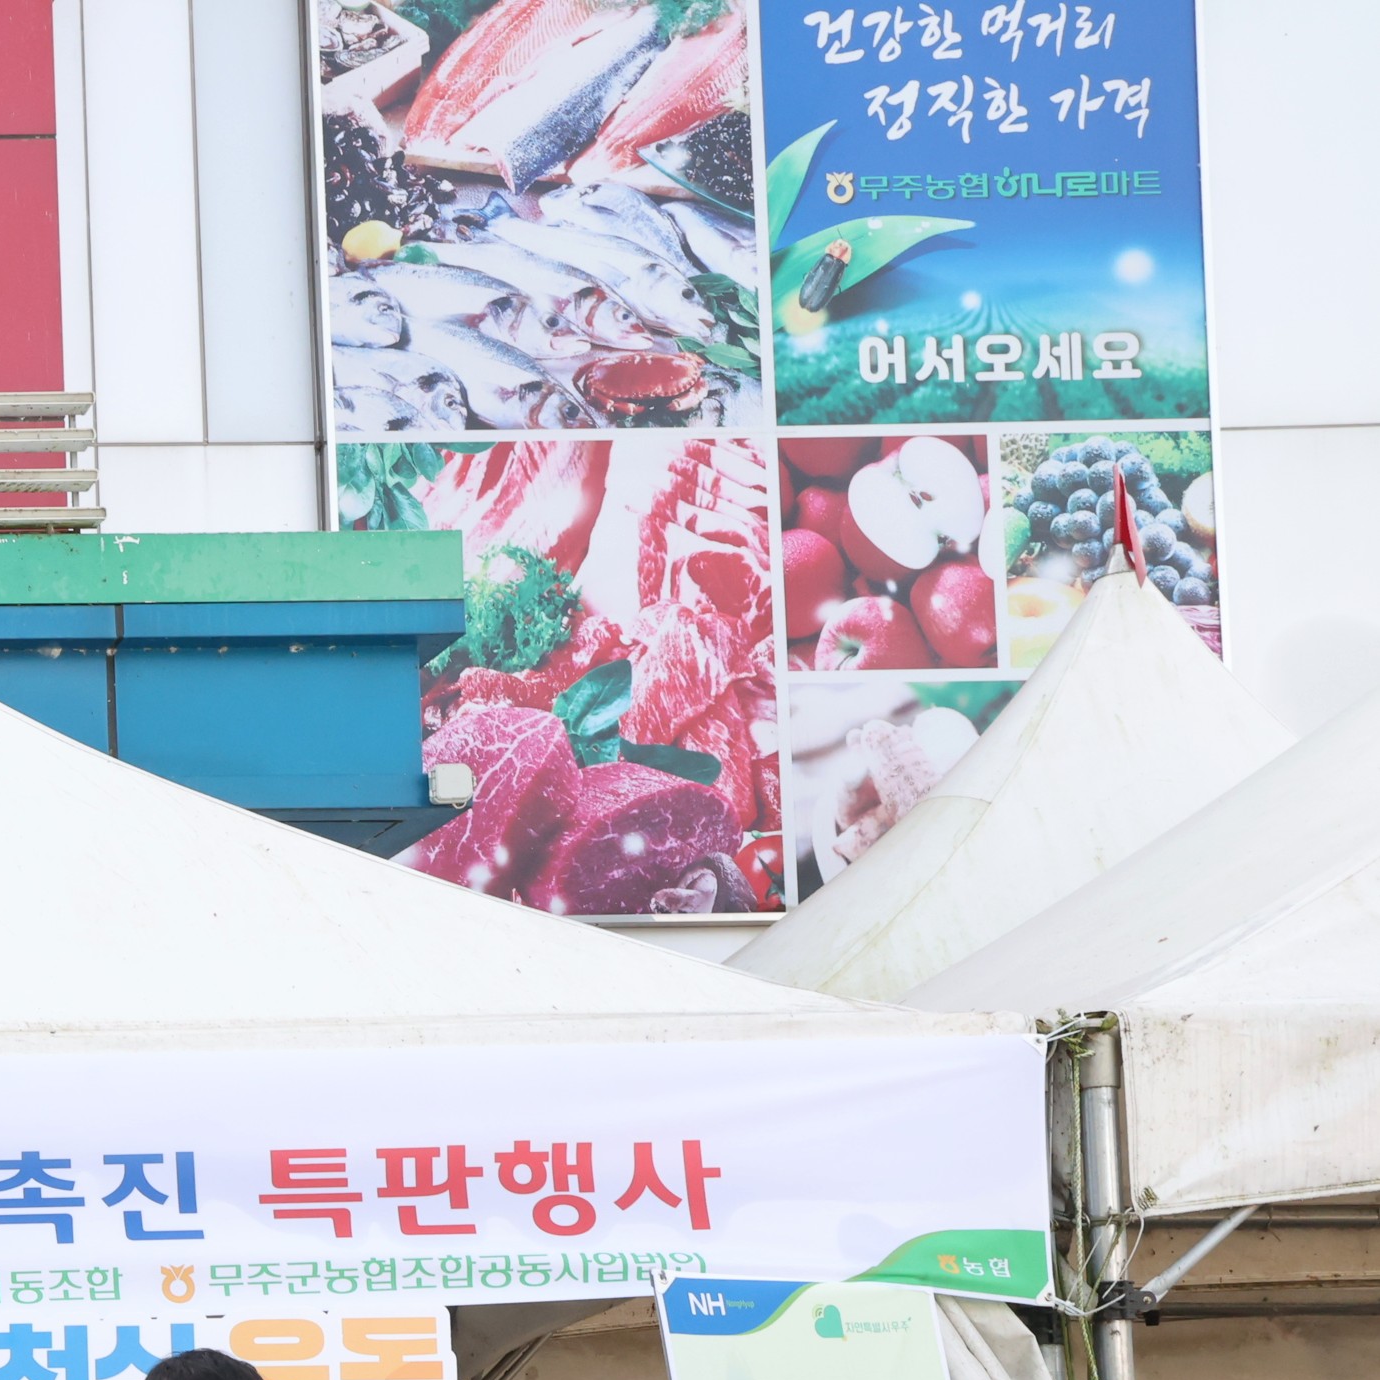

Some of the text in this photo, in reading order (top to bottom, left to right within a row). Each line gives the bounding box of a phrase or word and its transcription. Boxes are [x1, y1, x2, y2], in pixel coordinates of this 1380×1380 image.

[804, 0, 1116, 64] 건강한 먹거리
[864, 74, 1153, 143] 정직한 가격
[858, 331, 1142, 383] 어서오세요
[258, 1140, 721, 1238] 특판행사
[963, 1257, 1011, 1279] 농협
[690, 1293, 725, 1315] NH
